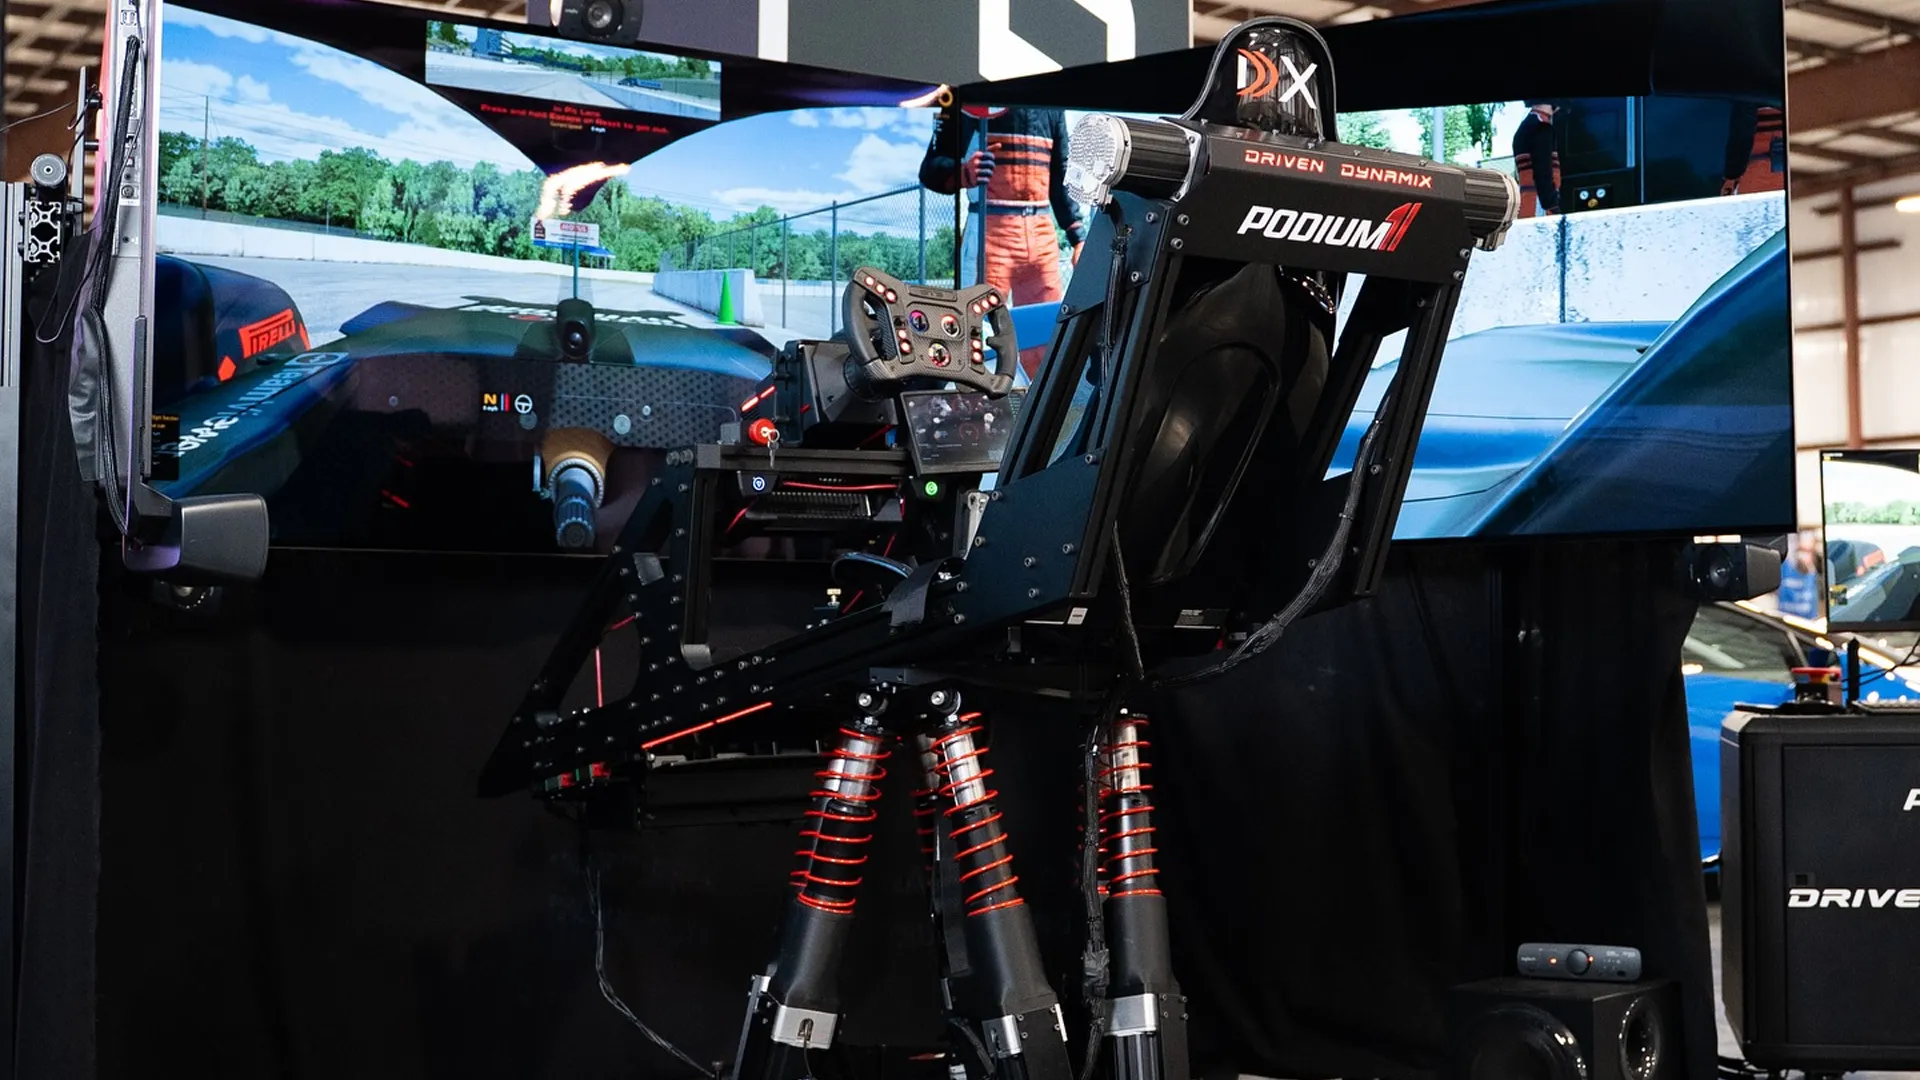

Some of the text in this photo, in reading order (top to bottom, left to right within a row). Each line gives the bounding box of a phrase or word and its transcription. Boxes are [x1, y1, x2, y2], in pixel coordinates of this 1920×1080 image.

[1244, 149, 1433, 189] DRIVEN DYNAMIX
[238, 308, 297, 360] PIRELLI
[483, 393, 497, 405] N
